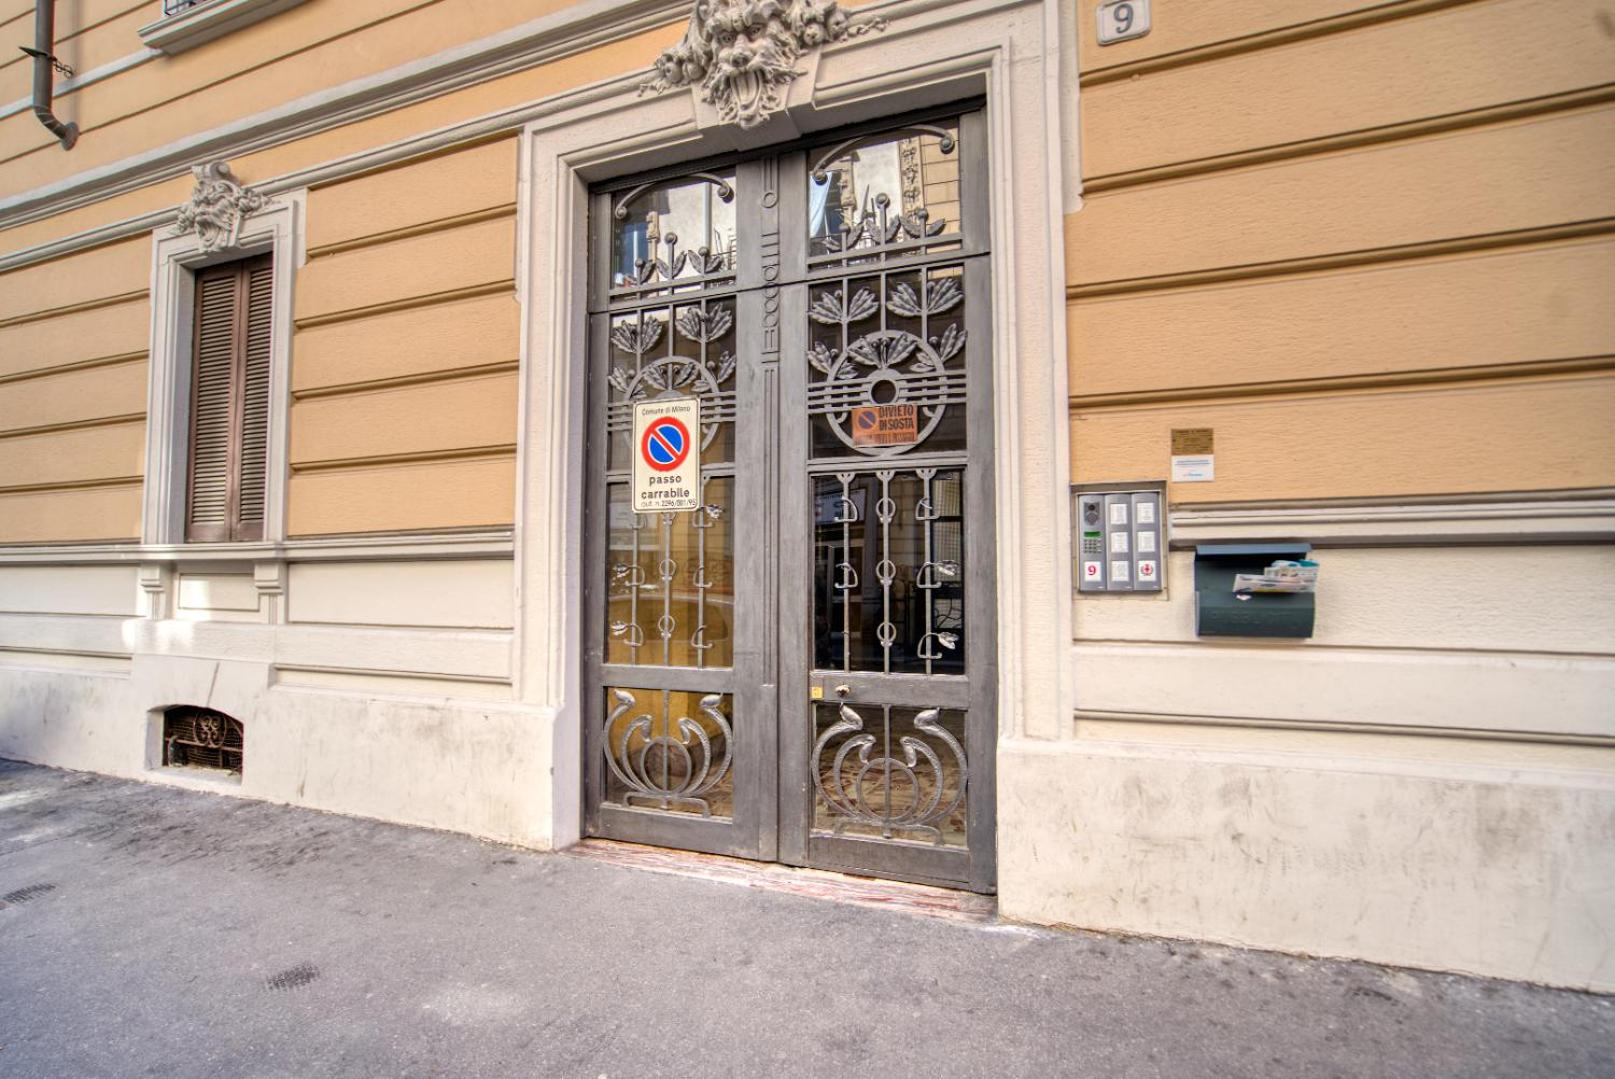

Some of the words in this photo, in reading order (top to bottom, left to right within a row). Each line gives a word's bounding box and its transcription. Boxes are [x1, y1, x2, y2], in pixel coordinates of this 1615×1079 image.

[1113, 3, 1134, 34] 9
[641, 408, 664, 416] Comune
[671, 405, 691, 413] Milano
[879, 404, 914, 418] DIVIETO
[879, 419, 887, 431] DI
[888, 417, 914, 430] SOSTA
[649, 475, 682, 486] passo
[641, 487, 690, 499] carrabile
[1087, 565, 1097, 576] 9
